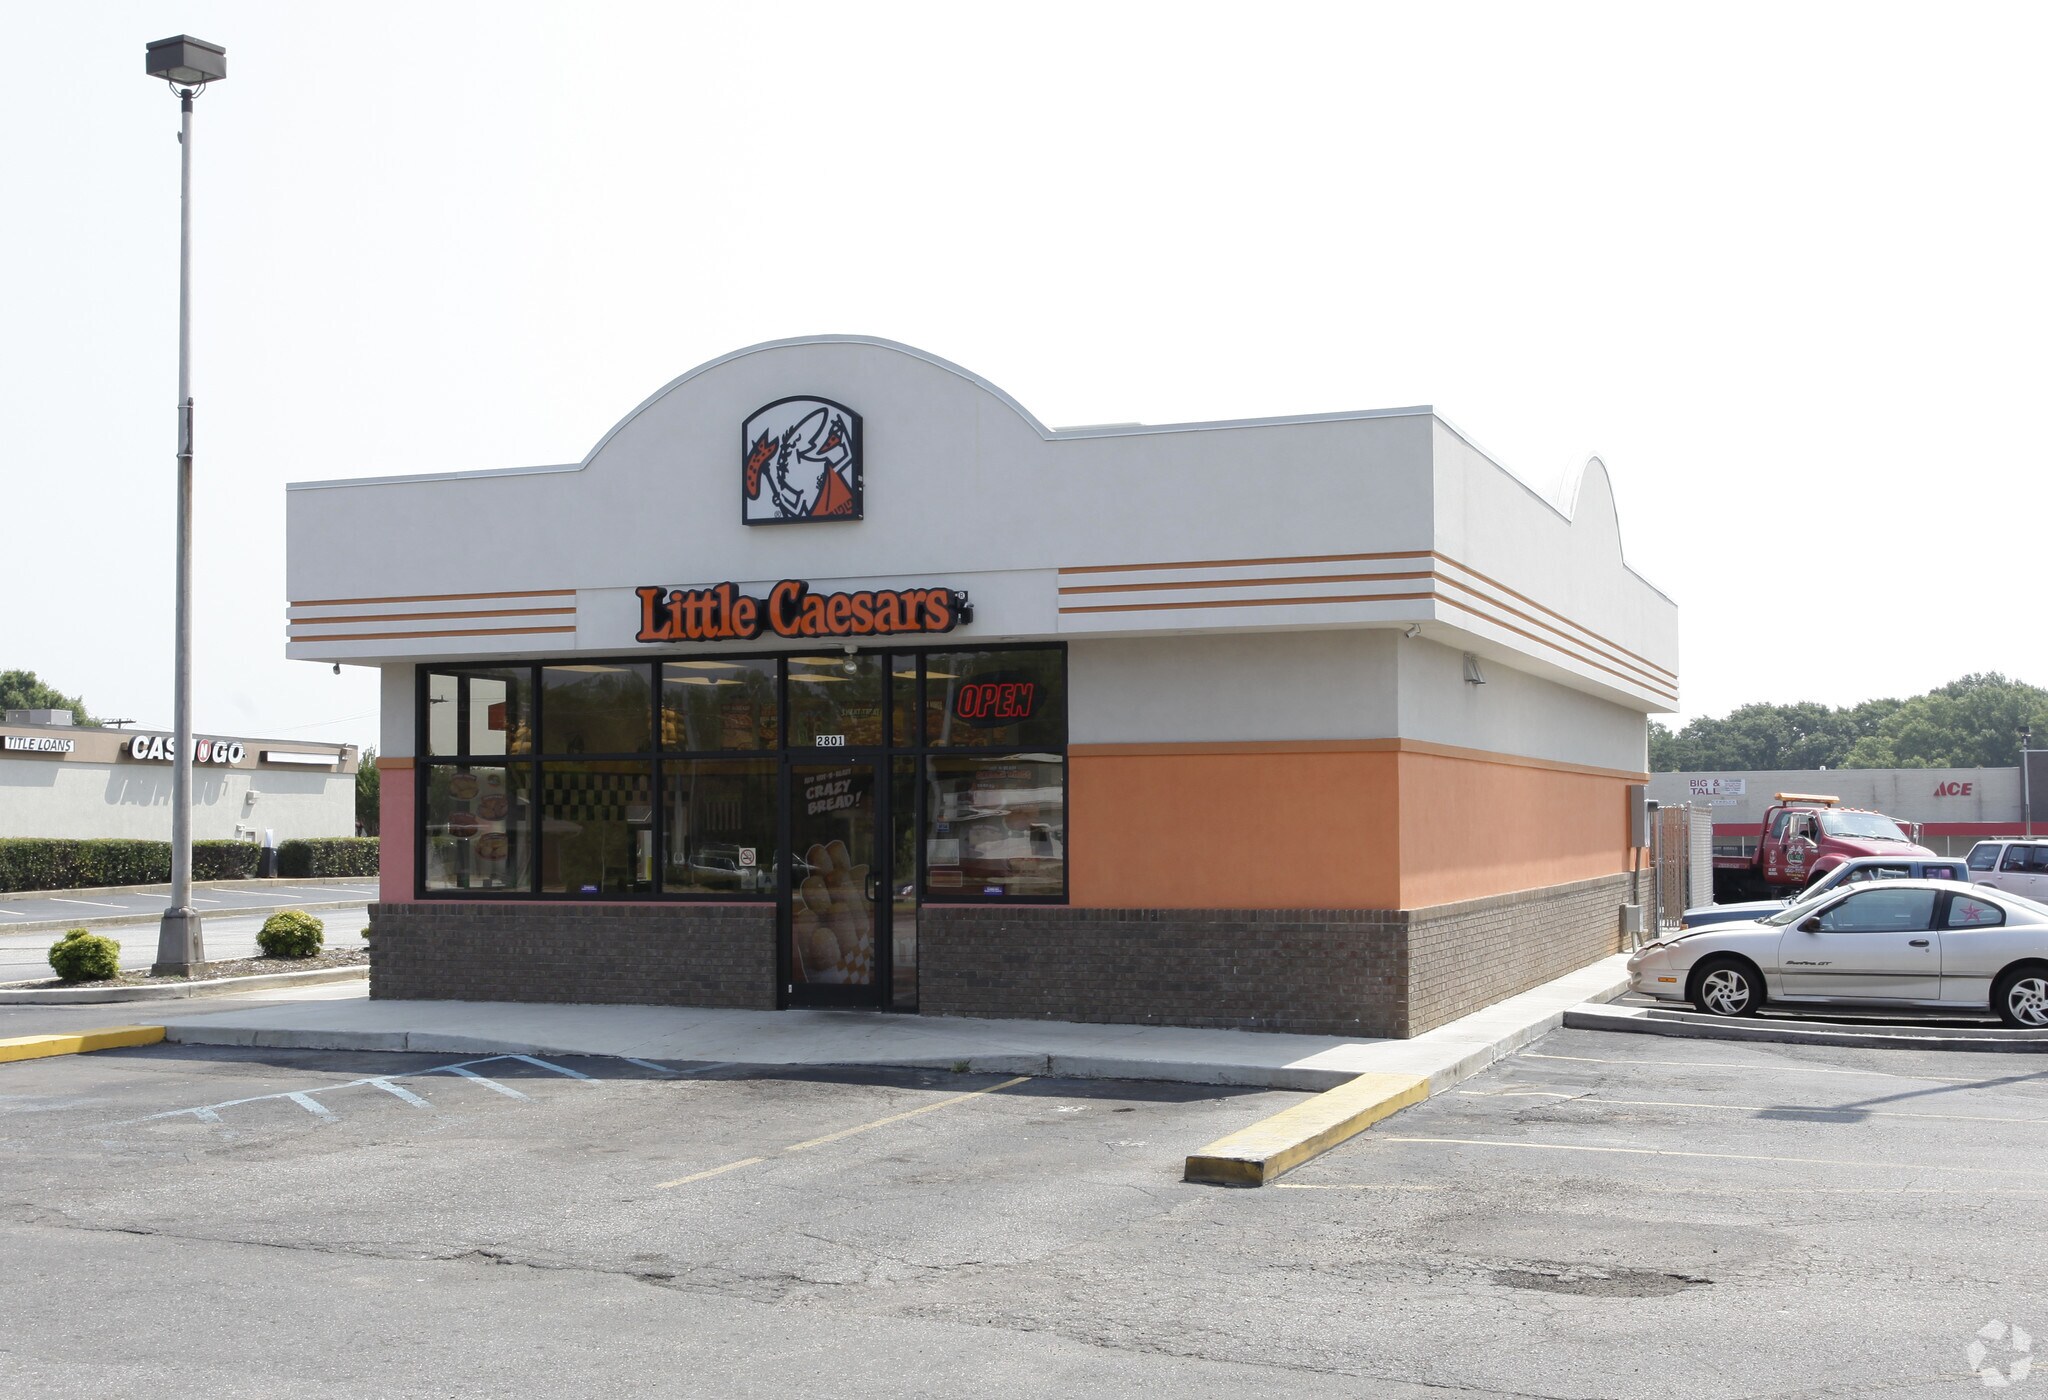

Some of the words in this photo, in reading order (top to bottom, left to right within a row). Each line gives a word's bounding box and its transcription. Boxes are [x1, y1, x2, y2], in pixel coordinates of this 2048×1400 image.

[636, 581, 758, 641] Little
[768, 580, 951, 636] Caesars
[957, 683, 1034, 717] OPEN
[8, 737, 35, 750] TITLE
[38, 739, 71, 751] LOANS
[817, 736, 843, 746] 2801
[212, 741, 243, 763] GO
[806, 779, 852, 800] CRAZY
[1689, 779, 1708, 787] BIG
[1713, 779, 1720, 787] &
[1690, 787, 1720, 795] TALL
[1933, 781, 1973, 796] ACE
[808, 790, 863, 815] BREAD!
